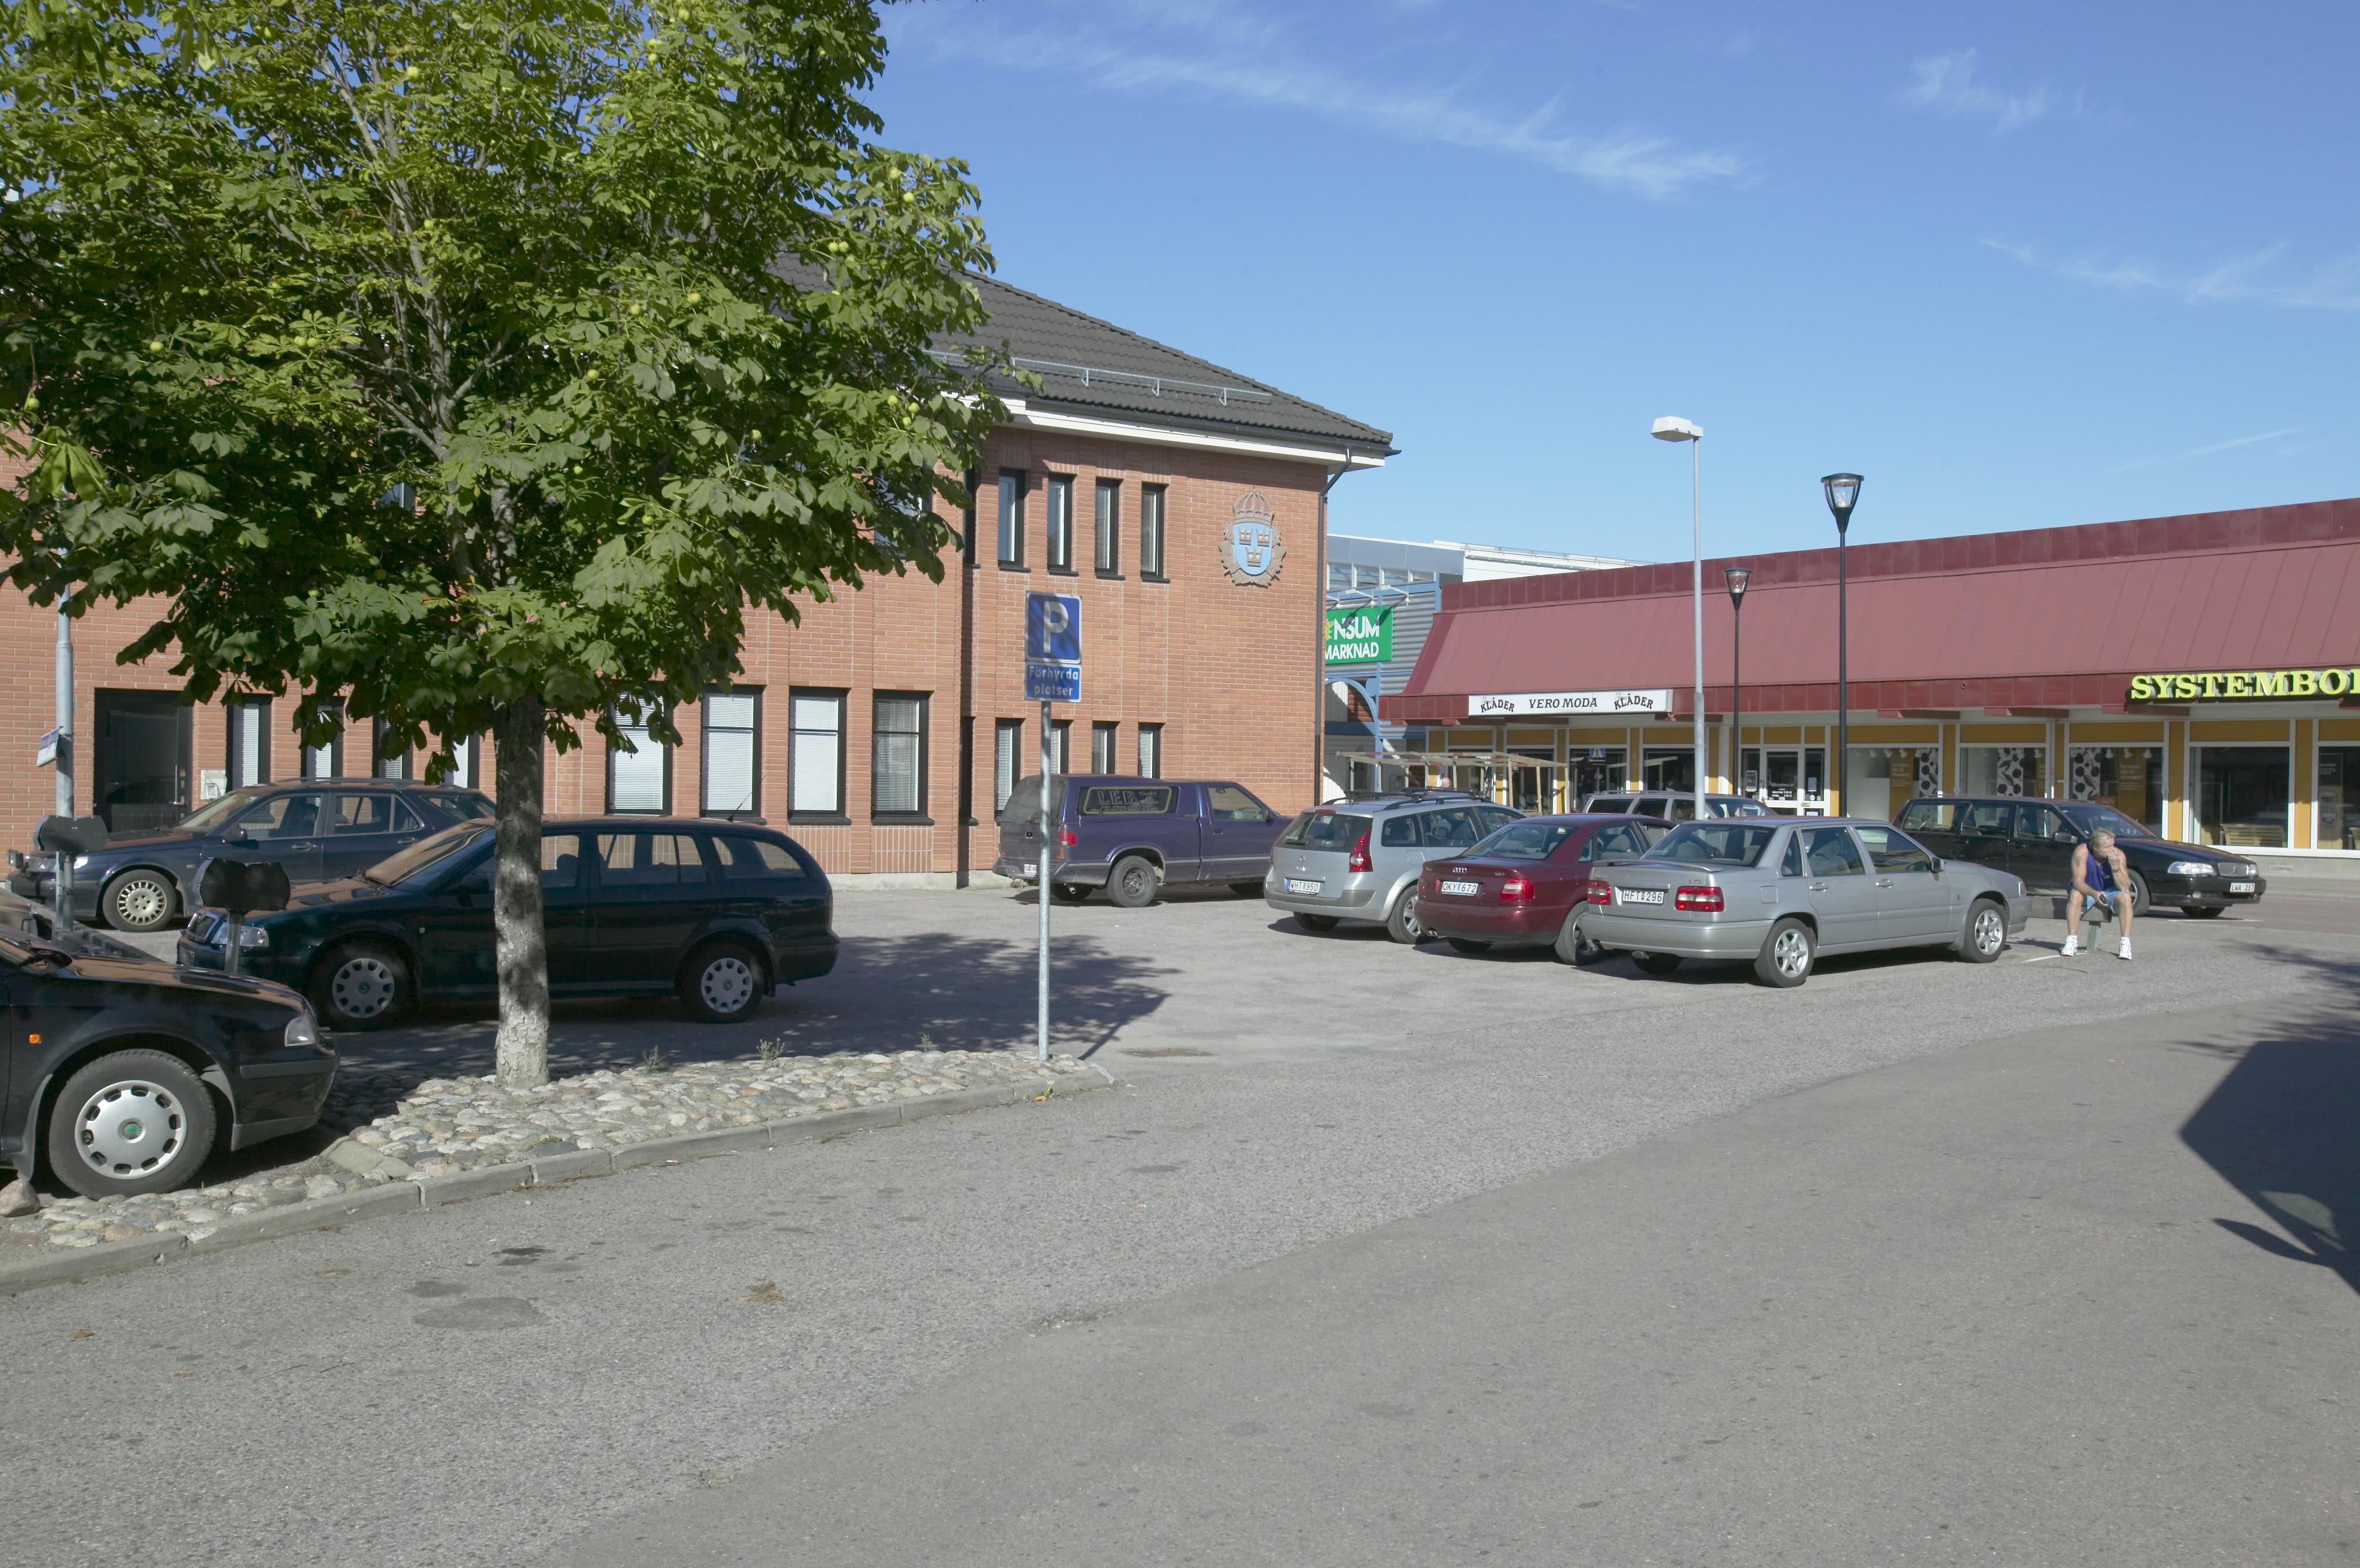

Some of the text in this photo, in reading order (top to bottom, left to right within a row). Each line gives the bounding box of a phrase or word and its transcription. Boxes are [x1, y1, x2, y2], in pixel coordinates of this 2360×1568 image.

[1044, 600, 1068, 653] P
[1325, 616, 1380, 640] NSUM
[1029, 666, 1078, 682] Förhyrda
[1034, 684, 1073, 696] platser
[1480, 697, 1514, 713] KLÄDER
[1529, 697, 1597, 709] VERO MODA
[1614, 693, 1653, 710] KLÄDER
[1306, 882, 1318, 891] 950
[1443, 882, 1477, 893] OKY 672
[1624, 890, 1662, 901] HFT 296
